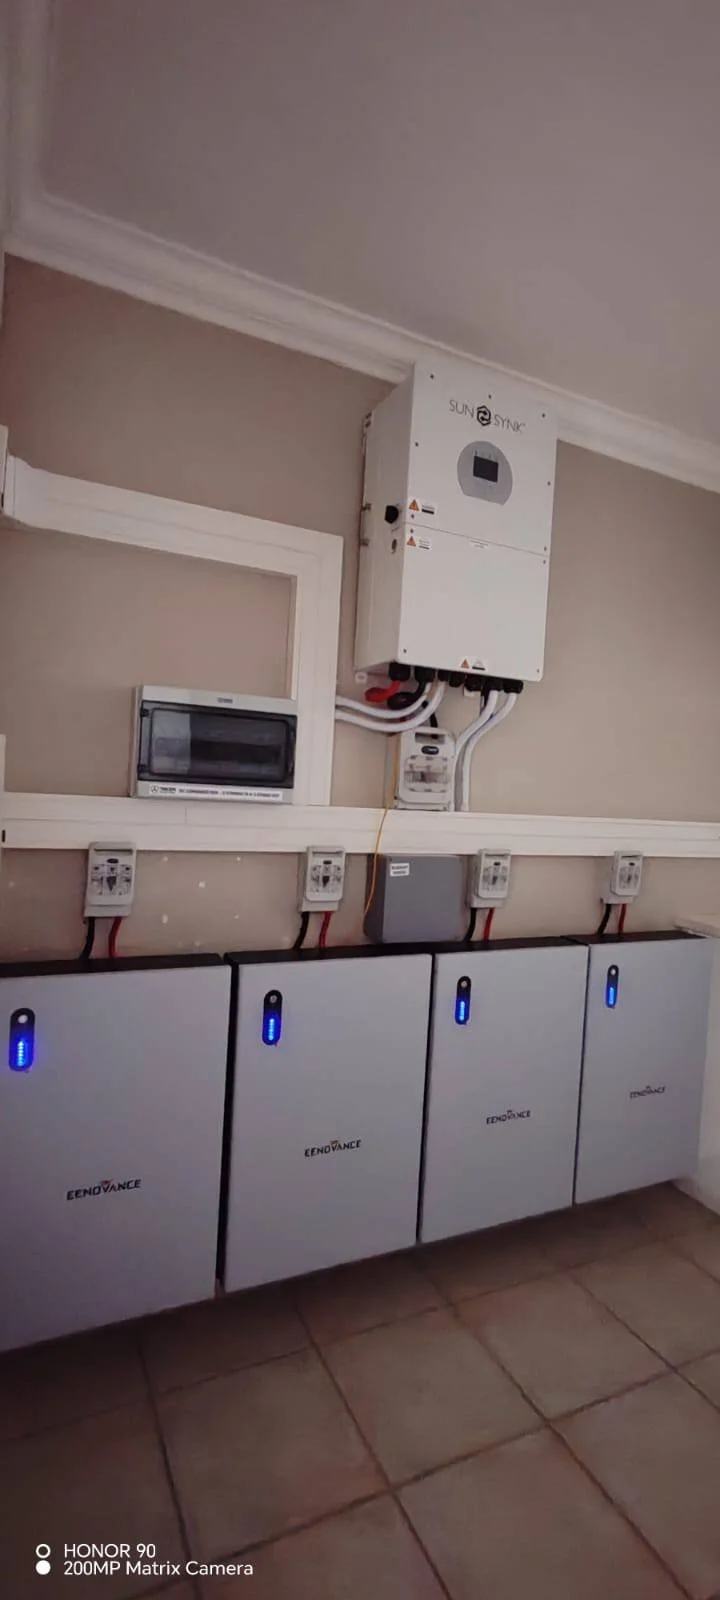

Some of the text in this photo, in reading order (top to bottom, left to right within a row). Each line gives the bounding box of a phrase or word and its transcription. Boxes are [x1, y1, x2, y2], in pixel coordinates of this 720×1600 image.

[449, 400, 475, 418] SUN
[304, 1139, 361, 1158] EENOVANCE
[66, 1178, 142, 1201] EENOVANCE
